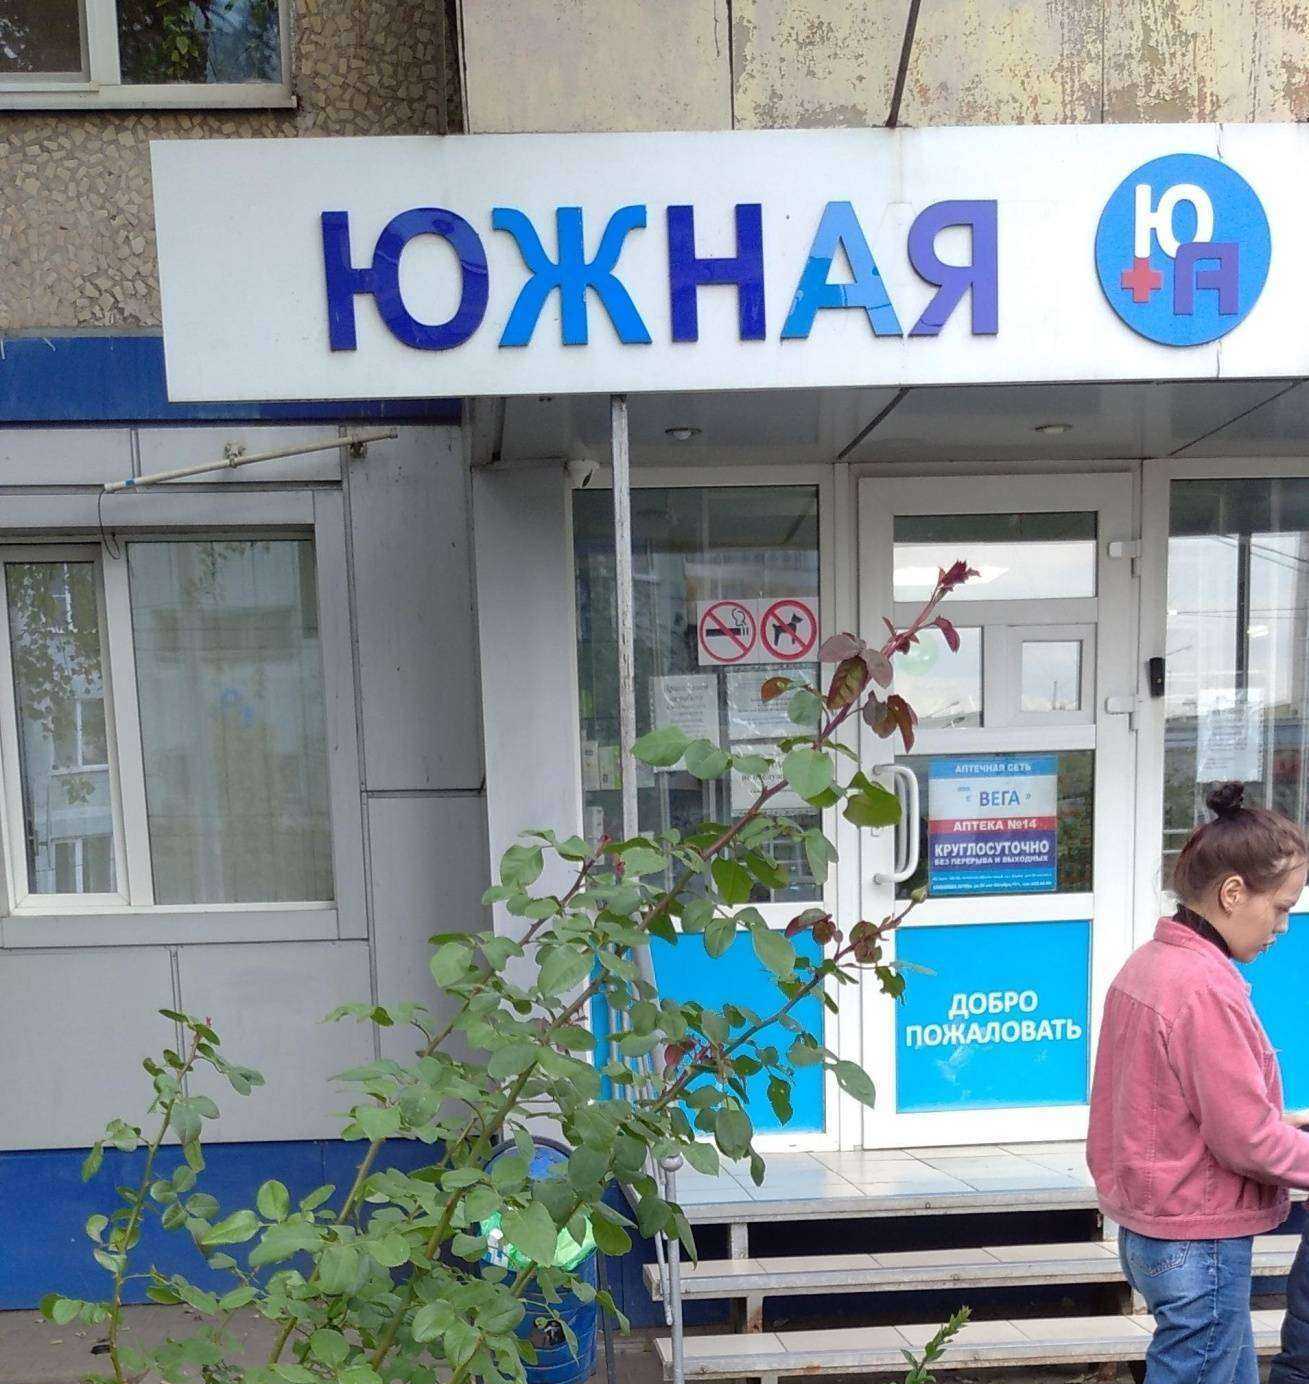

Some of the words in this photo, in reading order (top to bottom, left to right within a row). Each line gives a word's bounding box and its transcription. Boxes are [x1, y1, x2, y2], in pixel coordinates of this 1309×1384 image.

[321, 199, 999, 352] ЮЖНАЯ
[955, 763, 1005, 774] АПТЕЧНАЯ
[1007, 762, 1032, 773] СЕТЬ
[979, 790, 1021, 807] ВЕГА
[953, 820, 1004, 832] АПТЕКА
[1007, 818, 1038, 830] №14
[934, 840, 1050, 857] КРУГЛОСУТОЧНО
[934, 858, 950, 866] БЕЗ
[951, 857, 993, 866] ПЕРЕРЫВА
[1002, 855, 1049, 864] ВЫХОДНЫХ
[948, 990, 1039, 1020] ДОБРО
[905, 1018, 1083, 1047] ПОЖАЛОВАТЬ
